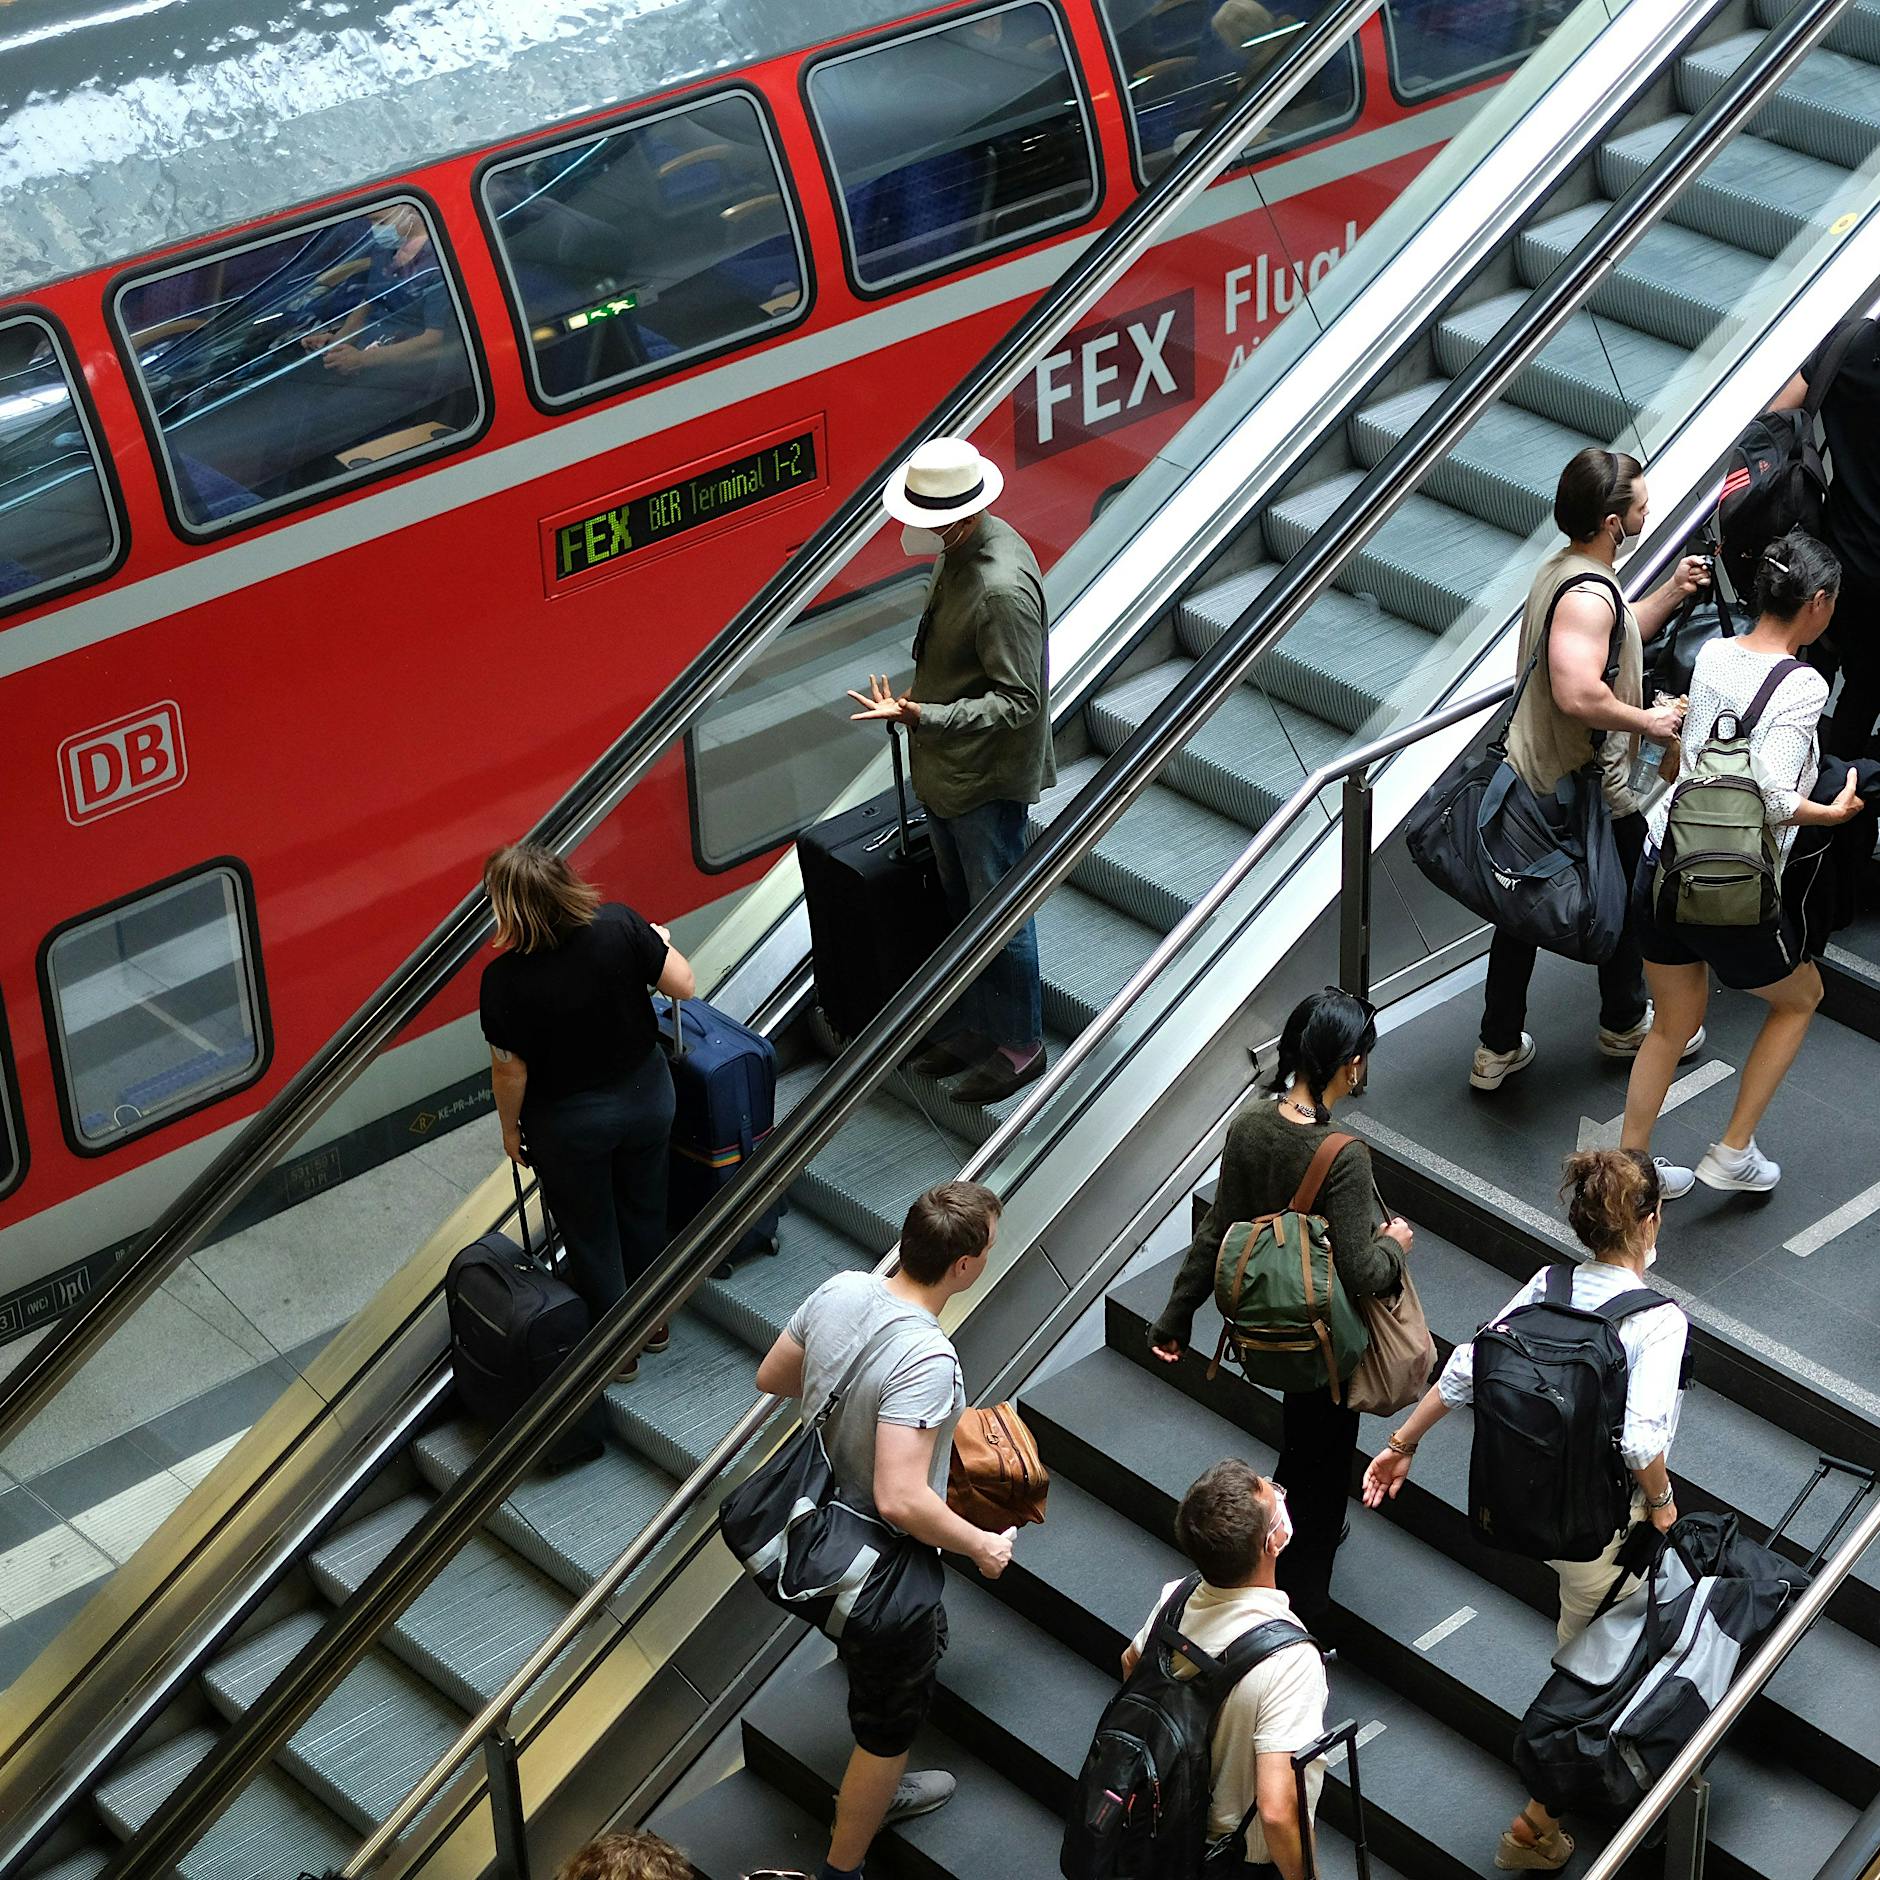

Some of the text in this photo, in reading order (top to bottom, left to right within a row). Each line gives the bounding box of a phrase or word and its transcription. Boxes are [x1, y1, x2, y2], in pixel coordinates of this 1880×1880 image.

[1225, 220, 1357, 334] Flu
[1036, 309, 1178, 444] FEX
[560, 443, 802, 573] FEX BER Terminal 1-2
[74, 721, 171, 808] DB
